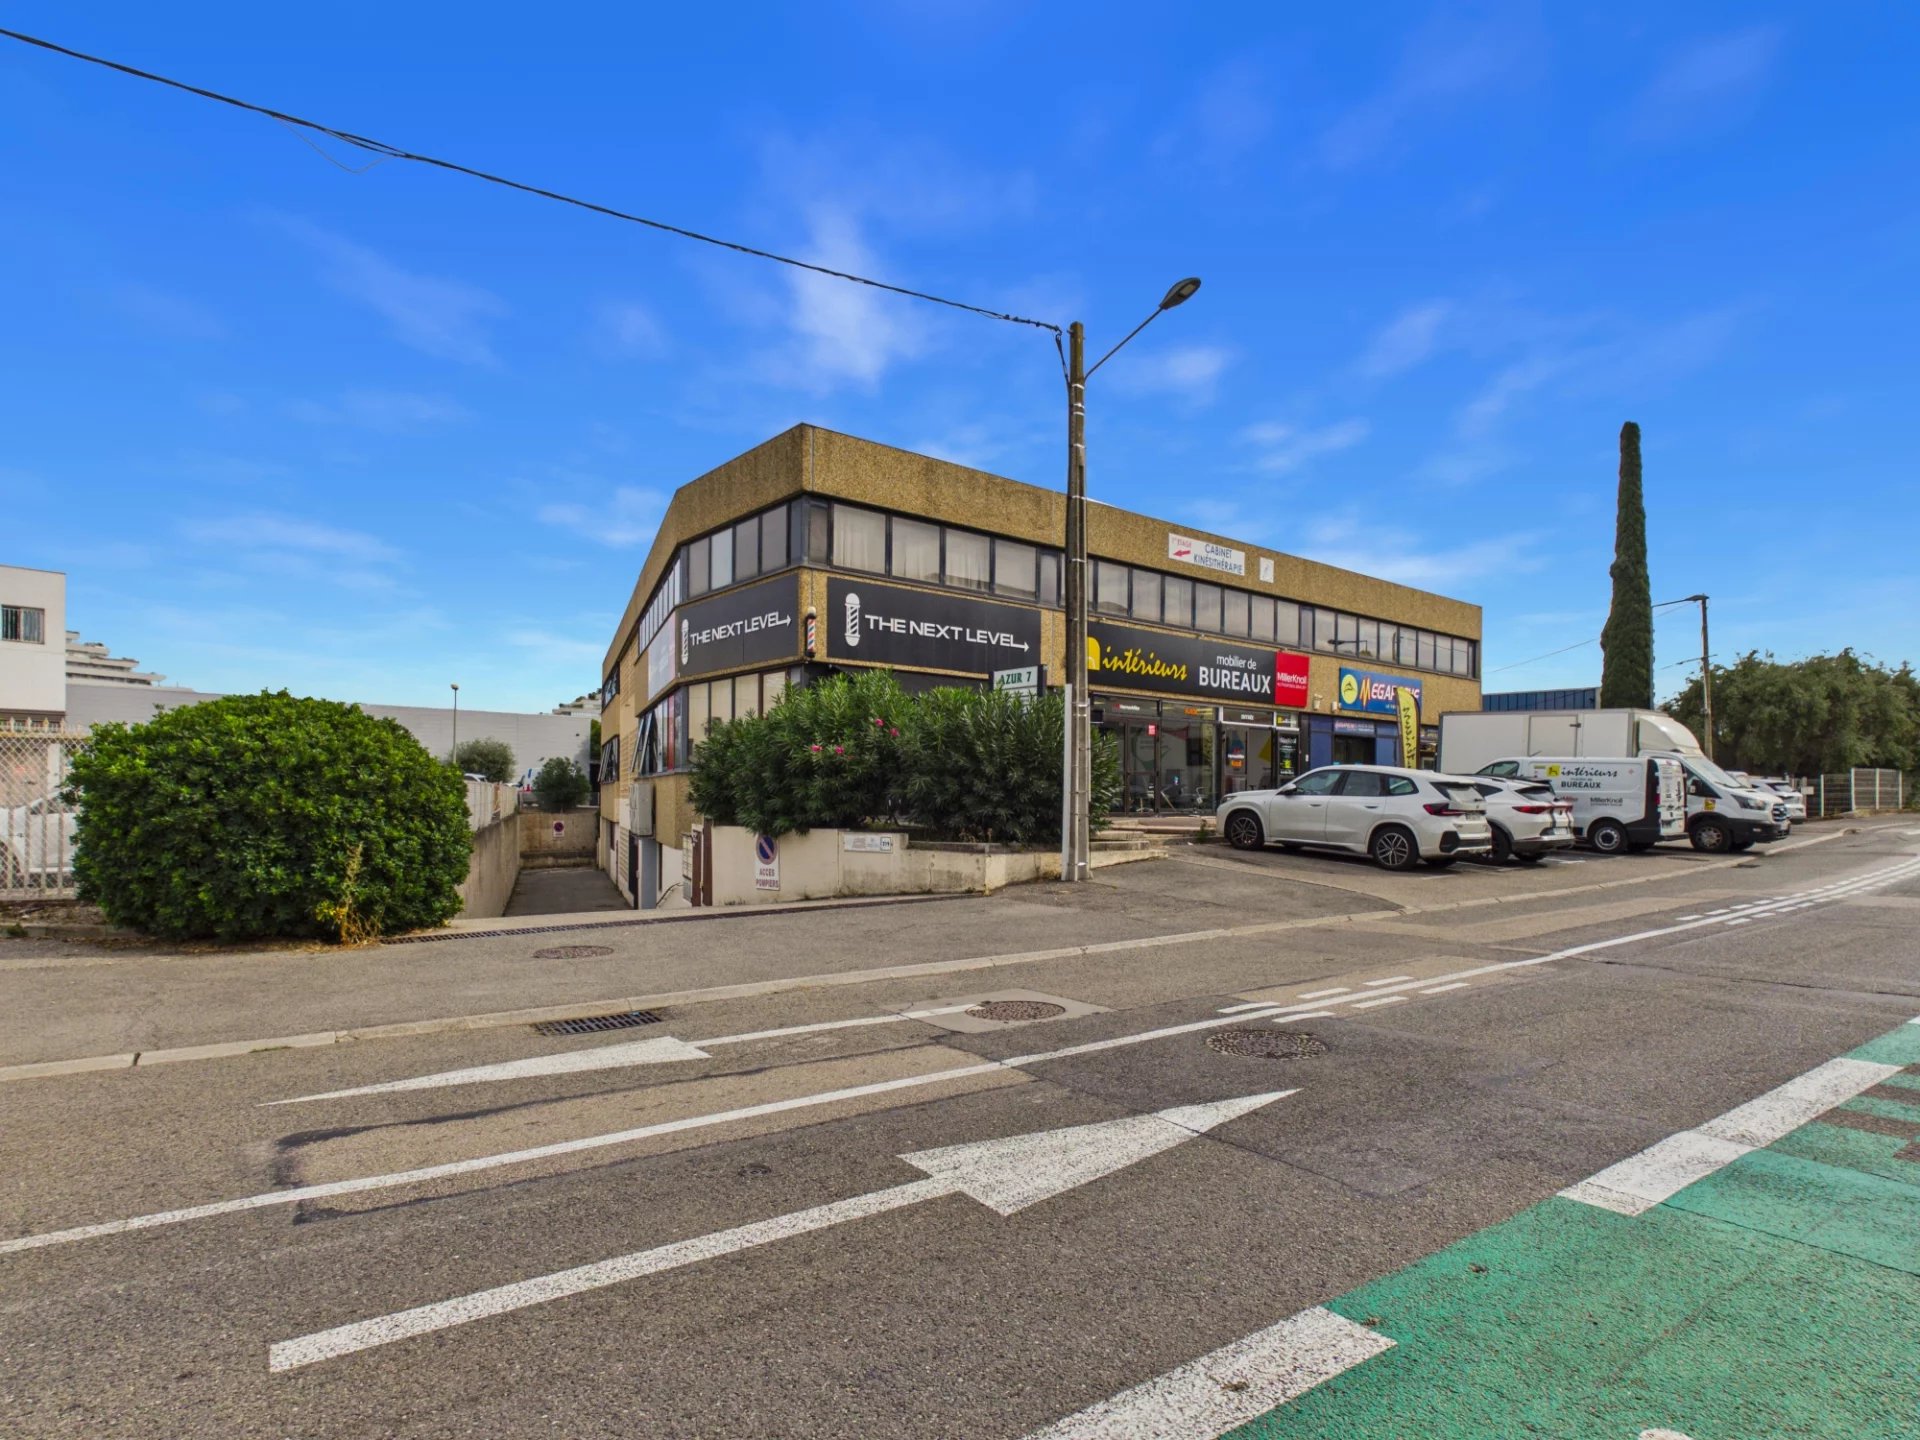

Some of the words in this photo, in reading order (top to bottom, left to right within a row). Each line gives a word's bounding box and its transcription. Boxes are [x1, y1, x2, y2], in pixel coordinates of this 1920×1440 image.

[690, 629, 711, 646] THE
[711, 621, 743, 641] NEXT
[744, 611, 791, 633] LEVEL
[864, 614, 906, 634] THE
[909, 620, 963, 640] NEXT
[966, 628, 1028, 652] LEVEL
[1102, 645, 1187, 680] intérieurs
[1216, 654, 1247, 668] mobilier
[1247, 658, 1257, 670] de
[999, 672, 1023, 685] AZUR
[1026, 671, 1032, 682] 7
[1198, 665, 1271, 694] BUREAUX
[1276, 671, 1307, 685] MillerKnoll
[1561, 766, 1618, 778] intérieurs
[1560, 781, 1601, 789] BUREAUX
[755, 878, 779, 888] POMPIERS
